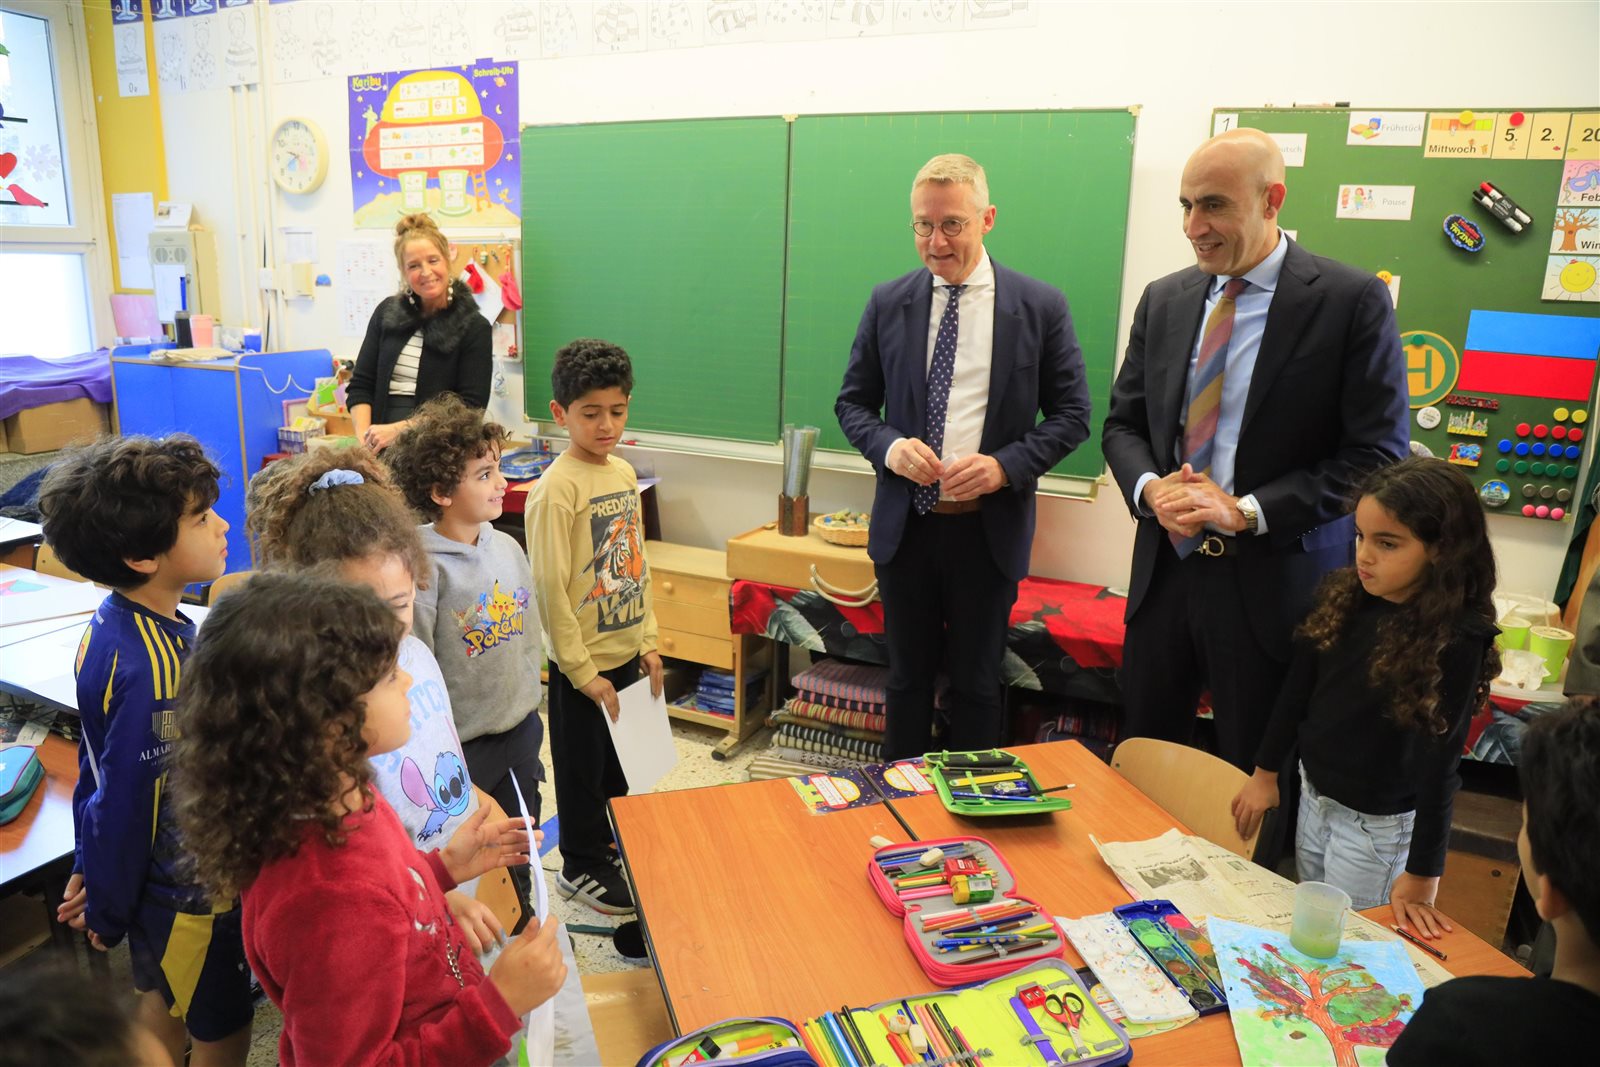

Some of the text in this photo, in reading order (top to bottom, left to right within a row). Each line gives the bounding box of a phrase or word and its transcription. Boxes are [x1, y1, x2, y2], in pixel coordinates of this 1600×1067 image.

[352, 76, 382, 89] Karibu
[1381, 119, 1423, 133] Frühstück
[1504, 128, 1518, 142] 5.
[1540, 128, 1555, 141] 2.
[1428, 144, 1476, 154] Mittwoch
[1382, 198, 1407, 207] Pause
